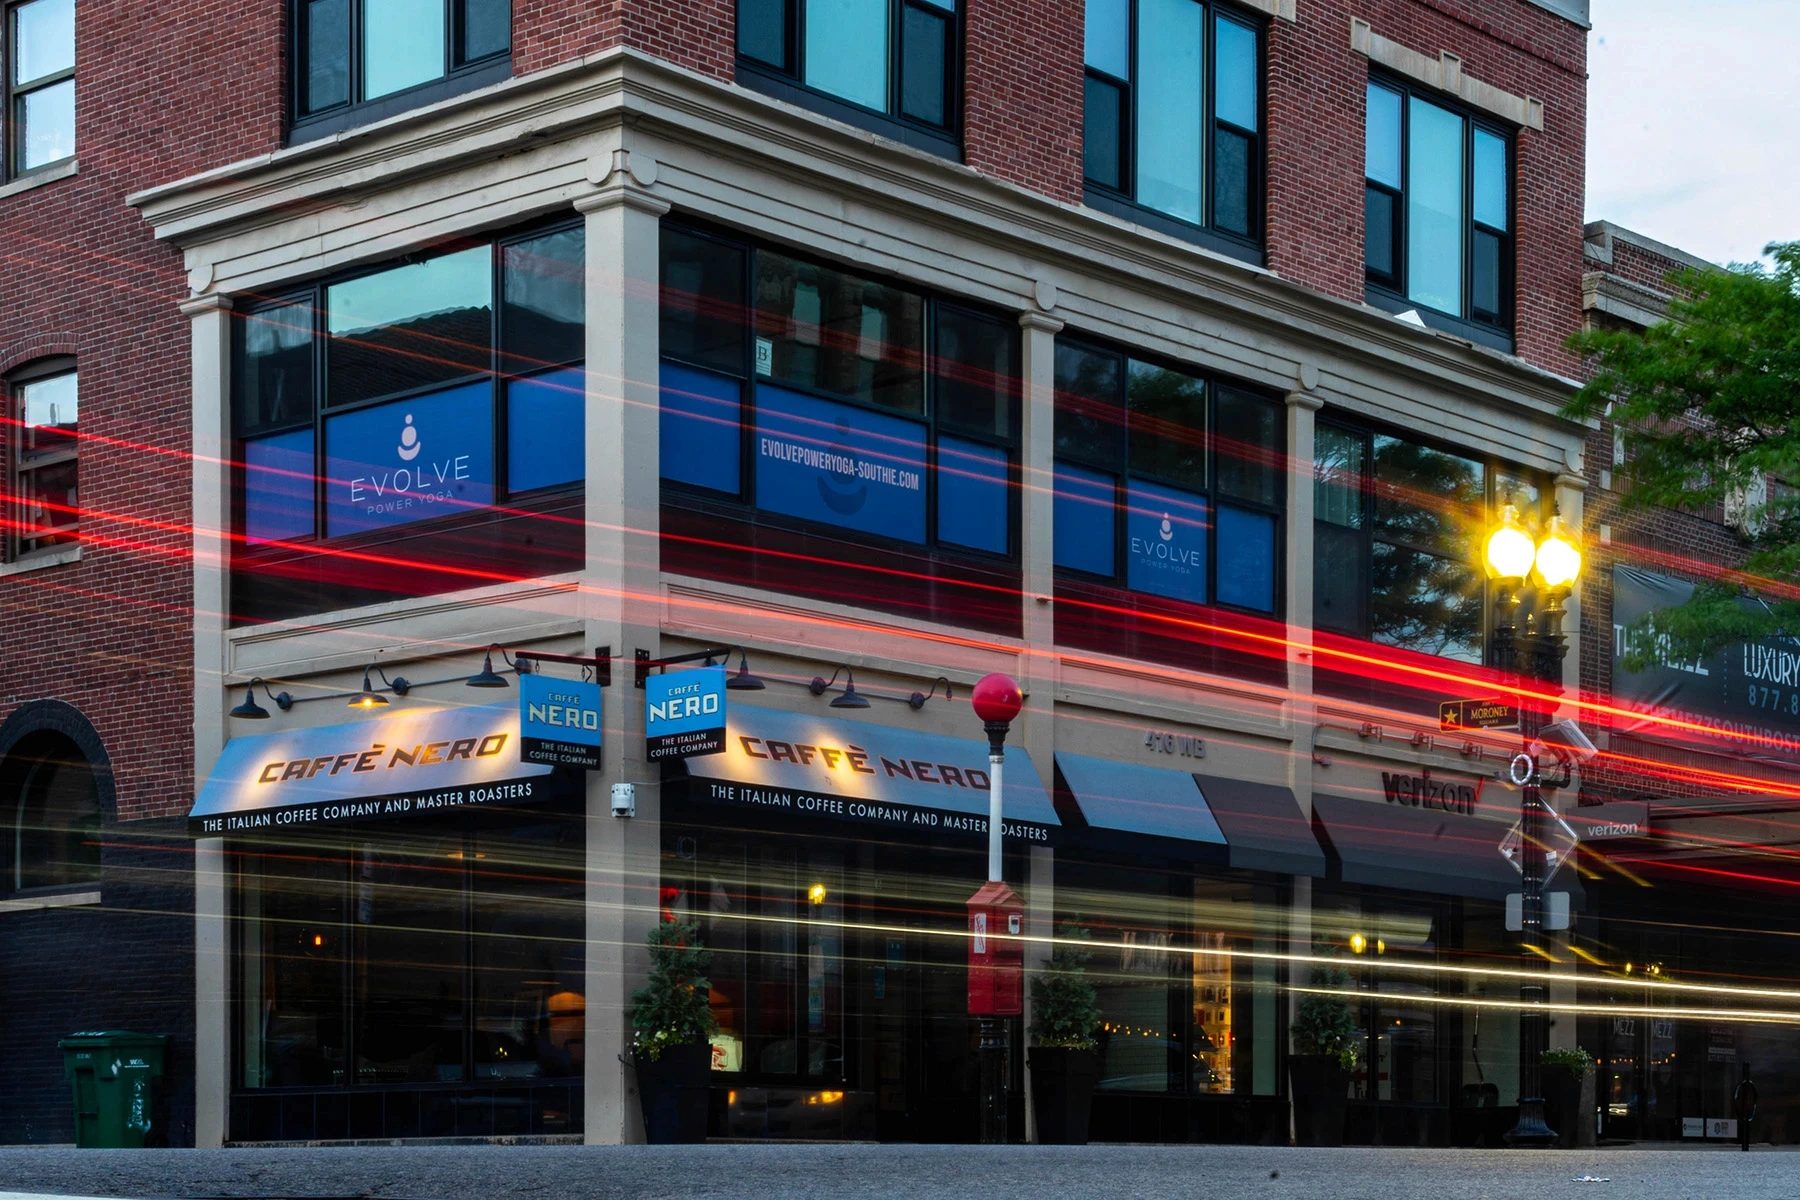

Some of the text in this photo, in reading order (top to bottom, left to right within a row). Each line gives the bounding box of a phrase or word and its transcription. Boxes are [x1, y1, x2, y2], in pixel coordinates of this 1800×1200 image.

[757, 345, 768, 361] B
[761, 438, 919, 490] EVOLVEPOWERYOGA-SOUTHIE.COM
[351, 455, 470, 502] EVOLVE
[367, 489, 453, 515] POWER YOGA
[1131, 537, 1200, 567] EVOLVE
[1744, 643, 1800, 688] LUXURY
[548, 692, 580, 705] CAFFÈ
[668, 682, 700, 696] CAFFÈ
[529, 702, 598, 730] NERO
[649, 693, 718, 723] NERO
[1471, 706, 1509, 720] MORONEY
[541, 741, 587, 754] THE ITALIAN
[650, 741, 718, 758] COFFEE COMPANY
[661, 733, 707, 746] THE ITALIAN
[258, 733, 508, 783] CAFFÈ NERO
[529, 750, 598, 766] COFFEE COMPANY
[739, 736, 991, 791] CAFFÈ NERO
[1382, 768, 1475, 815] verizon
[203, 783, 532, 832] THE ITALIAN COFFEE COMPANY AND MASTER ROASTERS
[711, 784, 1048, 841] THE ITALIAN COFFEE COMPANY AND MASTER OASTERS
[1588, 822, 1637, 836] verizon
[1613, 1016, 1636, 1037] MEZZ
